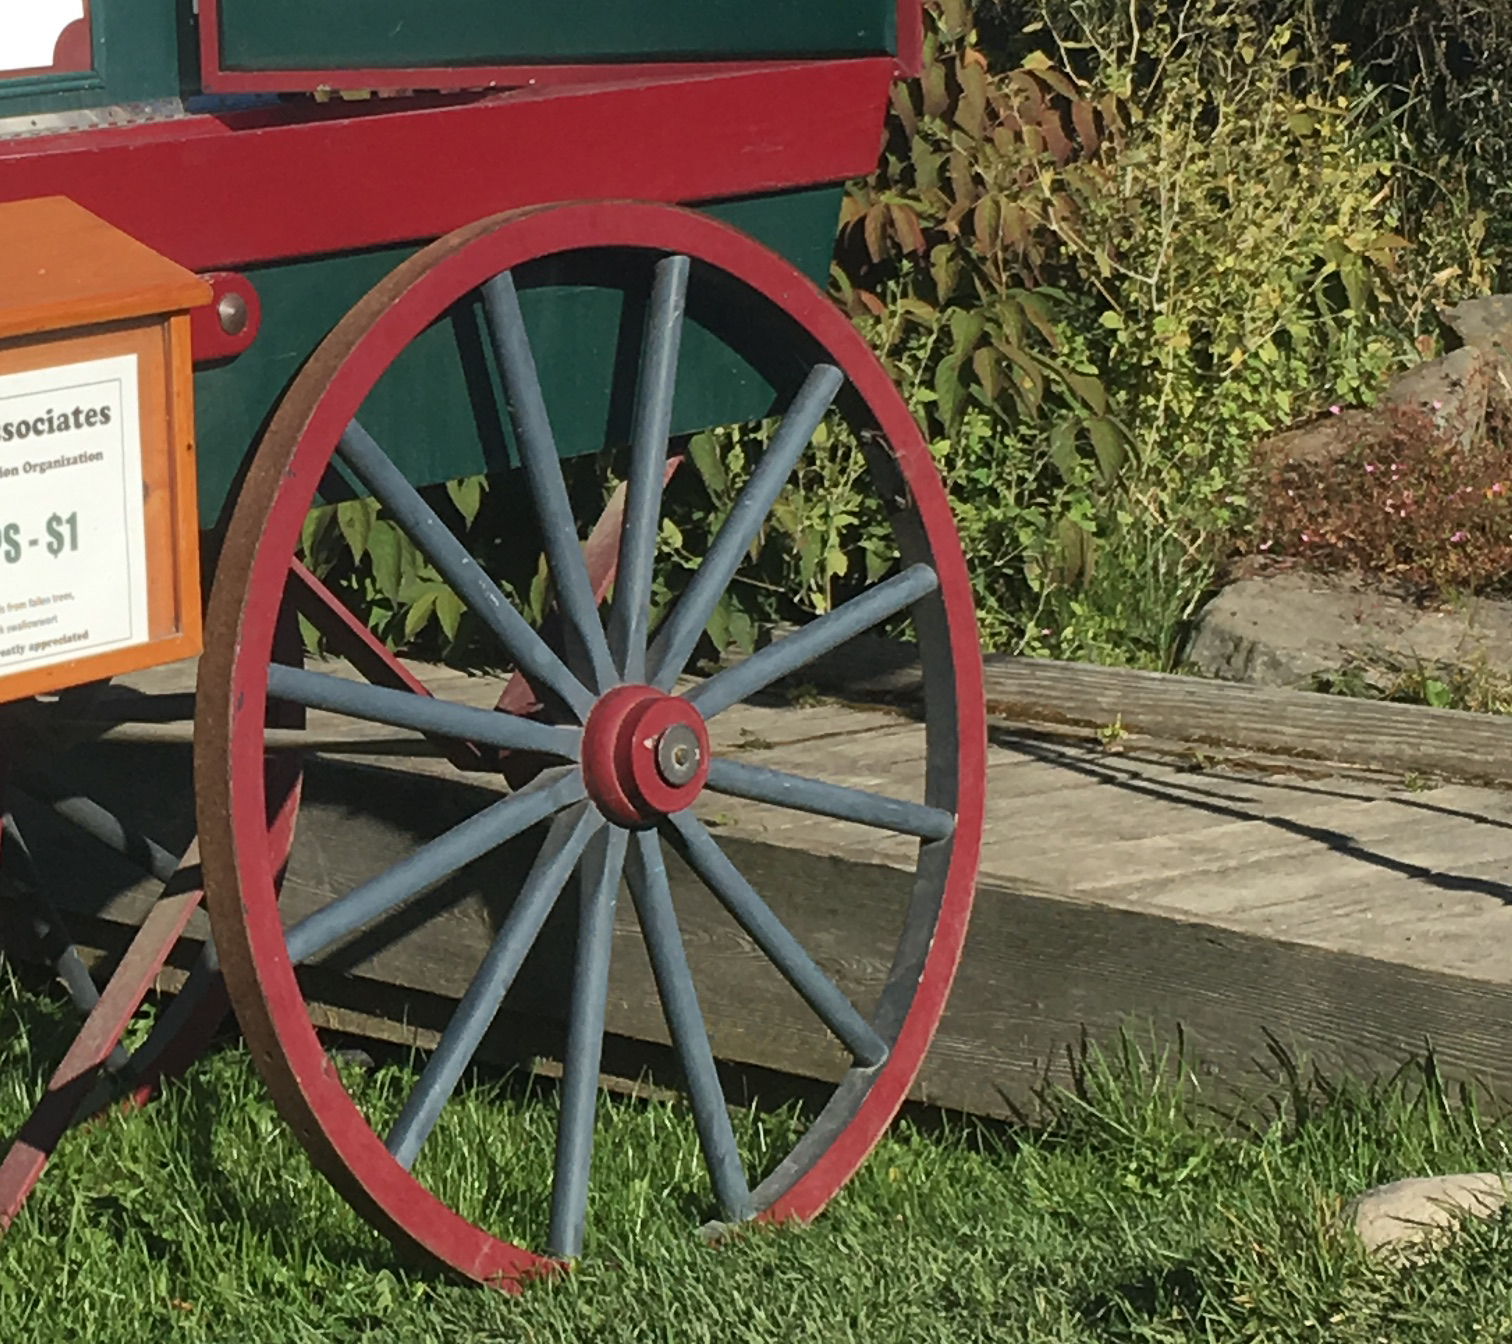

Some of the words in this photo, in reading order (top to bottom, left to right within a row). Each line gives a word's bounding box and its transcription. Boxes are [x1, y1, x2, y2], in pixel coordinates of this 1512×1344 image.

[22, 450, 103, 474] Organization
[28, 538, 39, 547] -
[45, 511, 78, 558] $1
[6, 601, 27, 612] from
[27, 596, 51, 608] fallen
[28, 628, 89, 652] appreciated
